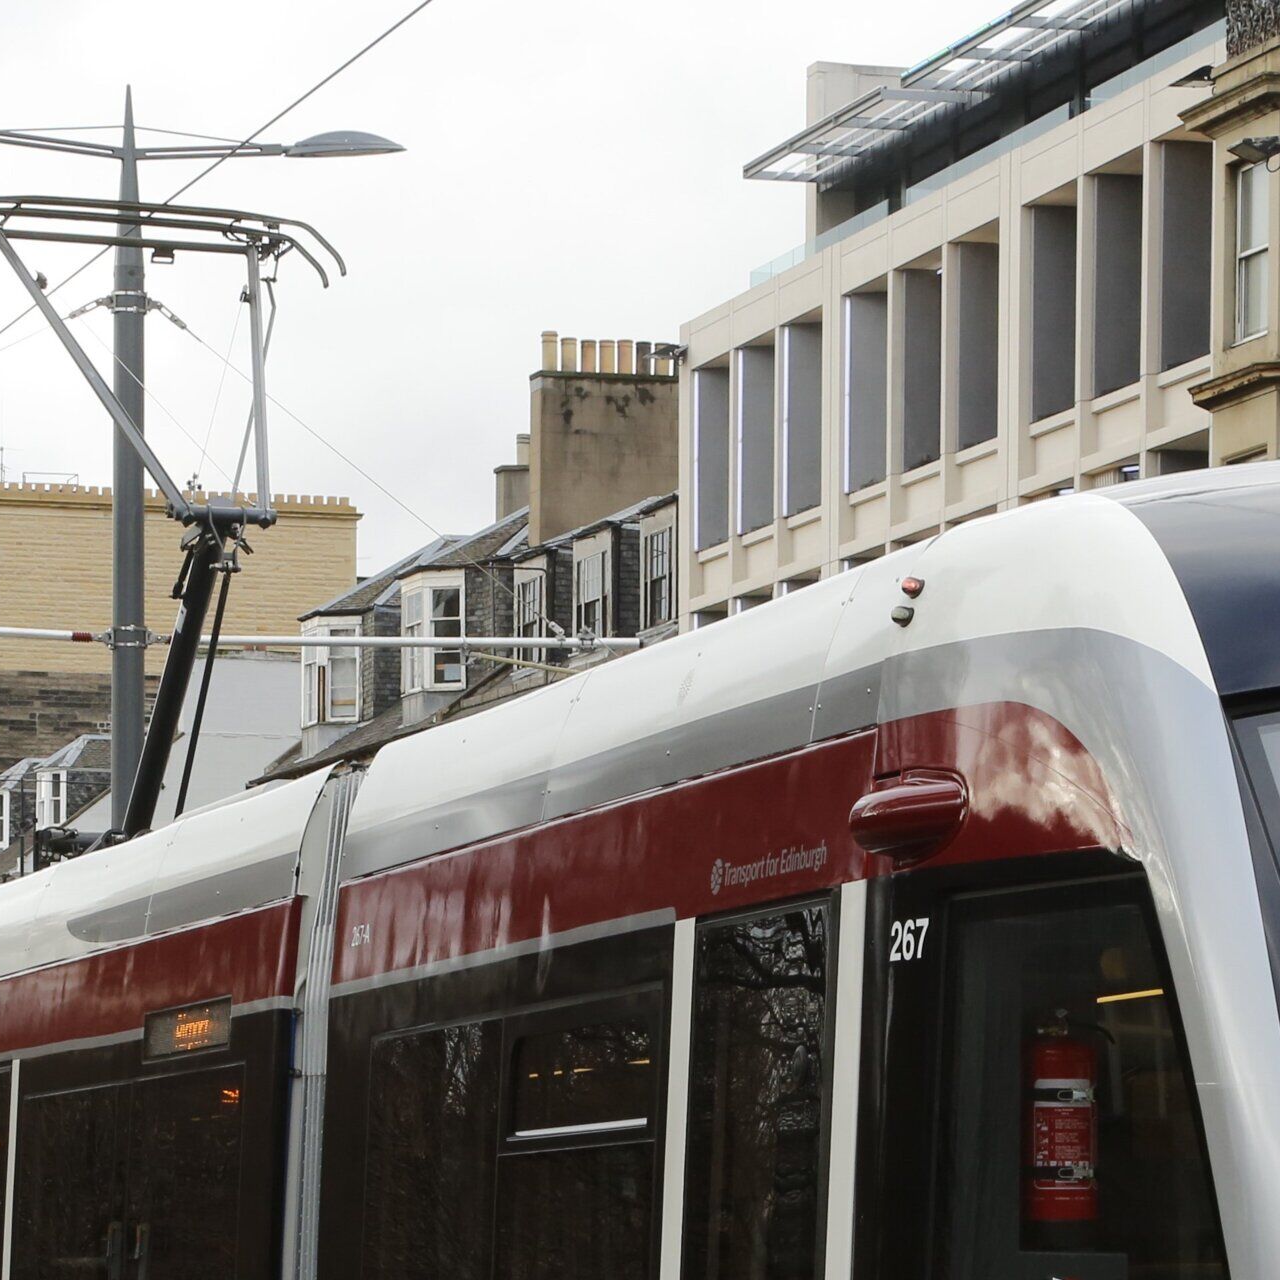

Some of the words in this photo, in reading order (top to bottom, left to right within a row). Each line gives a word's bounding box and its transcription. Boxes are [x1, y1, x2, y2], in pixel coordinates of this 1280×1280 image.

[724, 857, 765, 887] Transport
[765, 852, 779, 878] for
[780, 839, 827, 873] Edinburgh
[889, 917, 930, 962] 267
